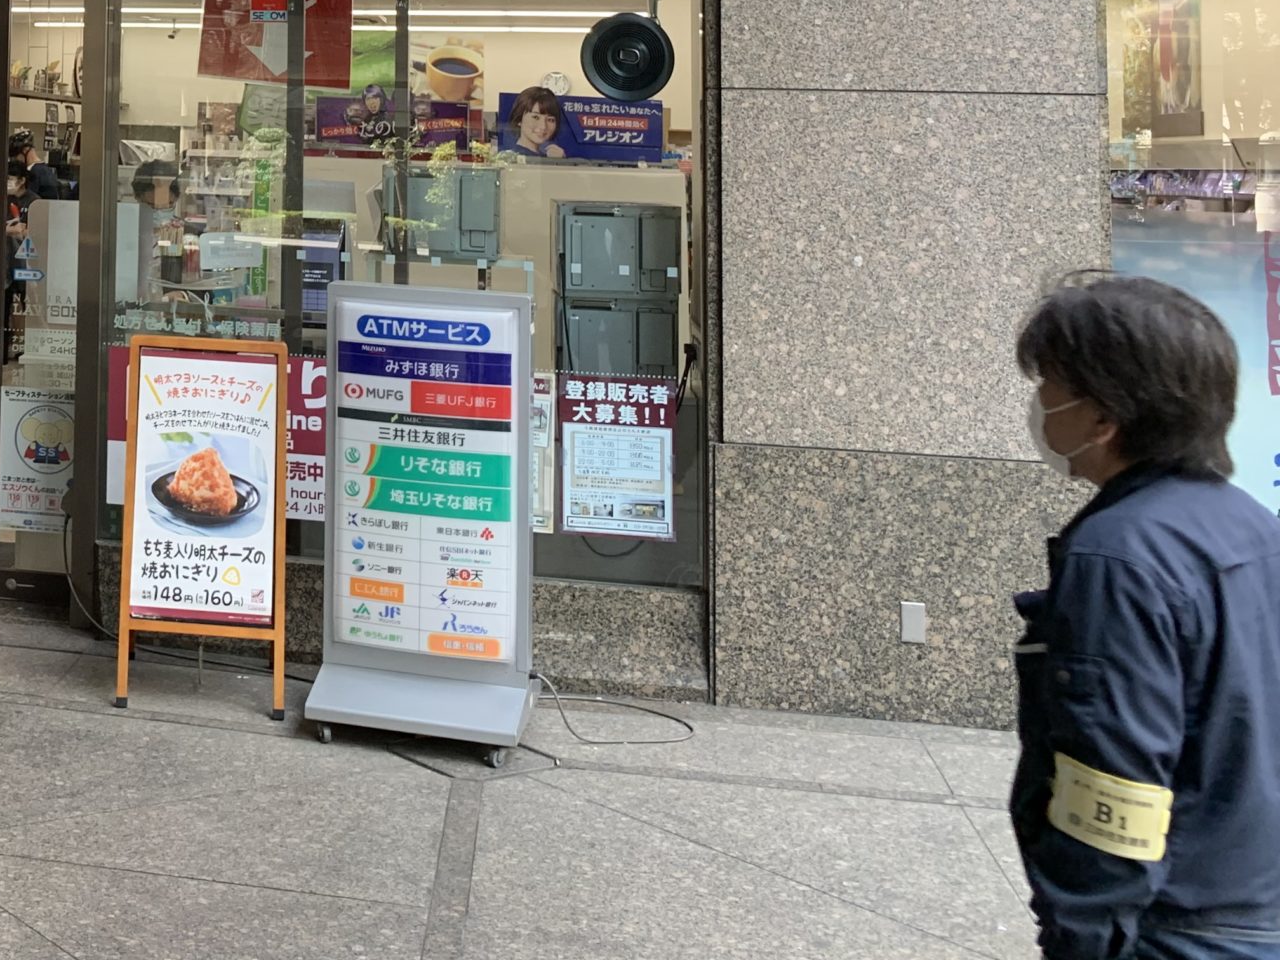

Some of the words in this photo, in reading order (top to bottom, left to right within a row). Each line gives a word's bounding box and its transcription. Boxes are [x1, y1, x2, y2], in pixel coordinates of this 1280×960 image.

[252, 11, 286, 21] SECOM
[583, 129, 644, 144] アレジオン
[363, 318, 483, 343] ATMサービス
[385, 358, 460, 380] みずほ銀行
[153, 373, 264, 392] 明太マヨソースとチーズの
[366, 386, 404, 401] MUFG
[565, 380, 670, 405] 登録販売者
[424, 394, 497, 409] 三菱UFJ銀行
[378, 426, 466, 447] 三井住友銀行
[38, 447, 56, 457] SS
[400, 455, 483, 478] りそな銀行
[390, 488, 493, 512] 埼玉りそな銀行
[360, 516, 409, 532] きらぼし銀行
[436, 526, 478, 538] 東日本銀行
[143, 539, 266, 565] もち麦入り明太チーズの
[367, 540, 404, 554] 新生銀行
[141, 560, 218, 583] 焼おにぎり
[367, 563, 402, 575] ソニー銀行
